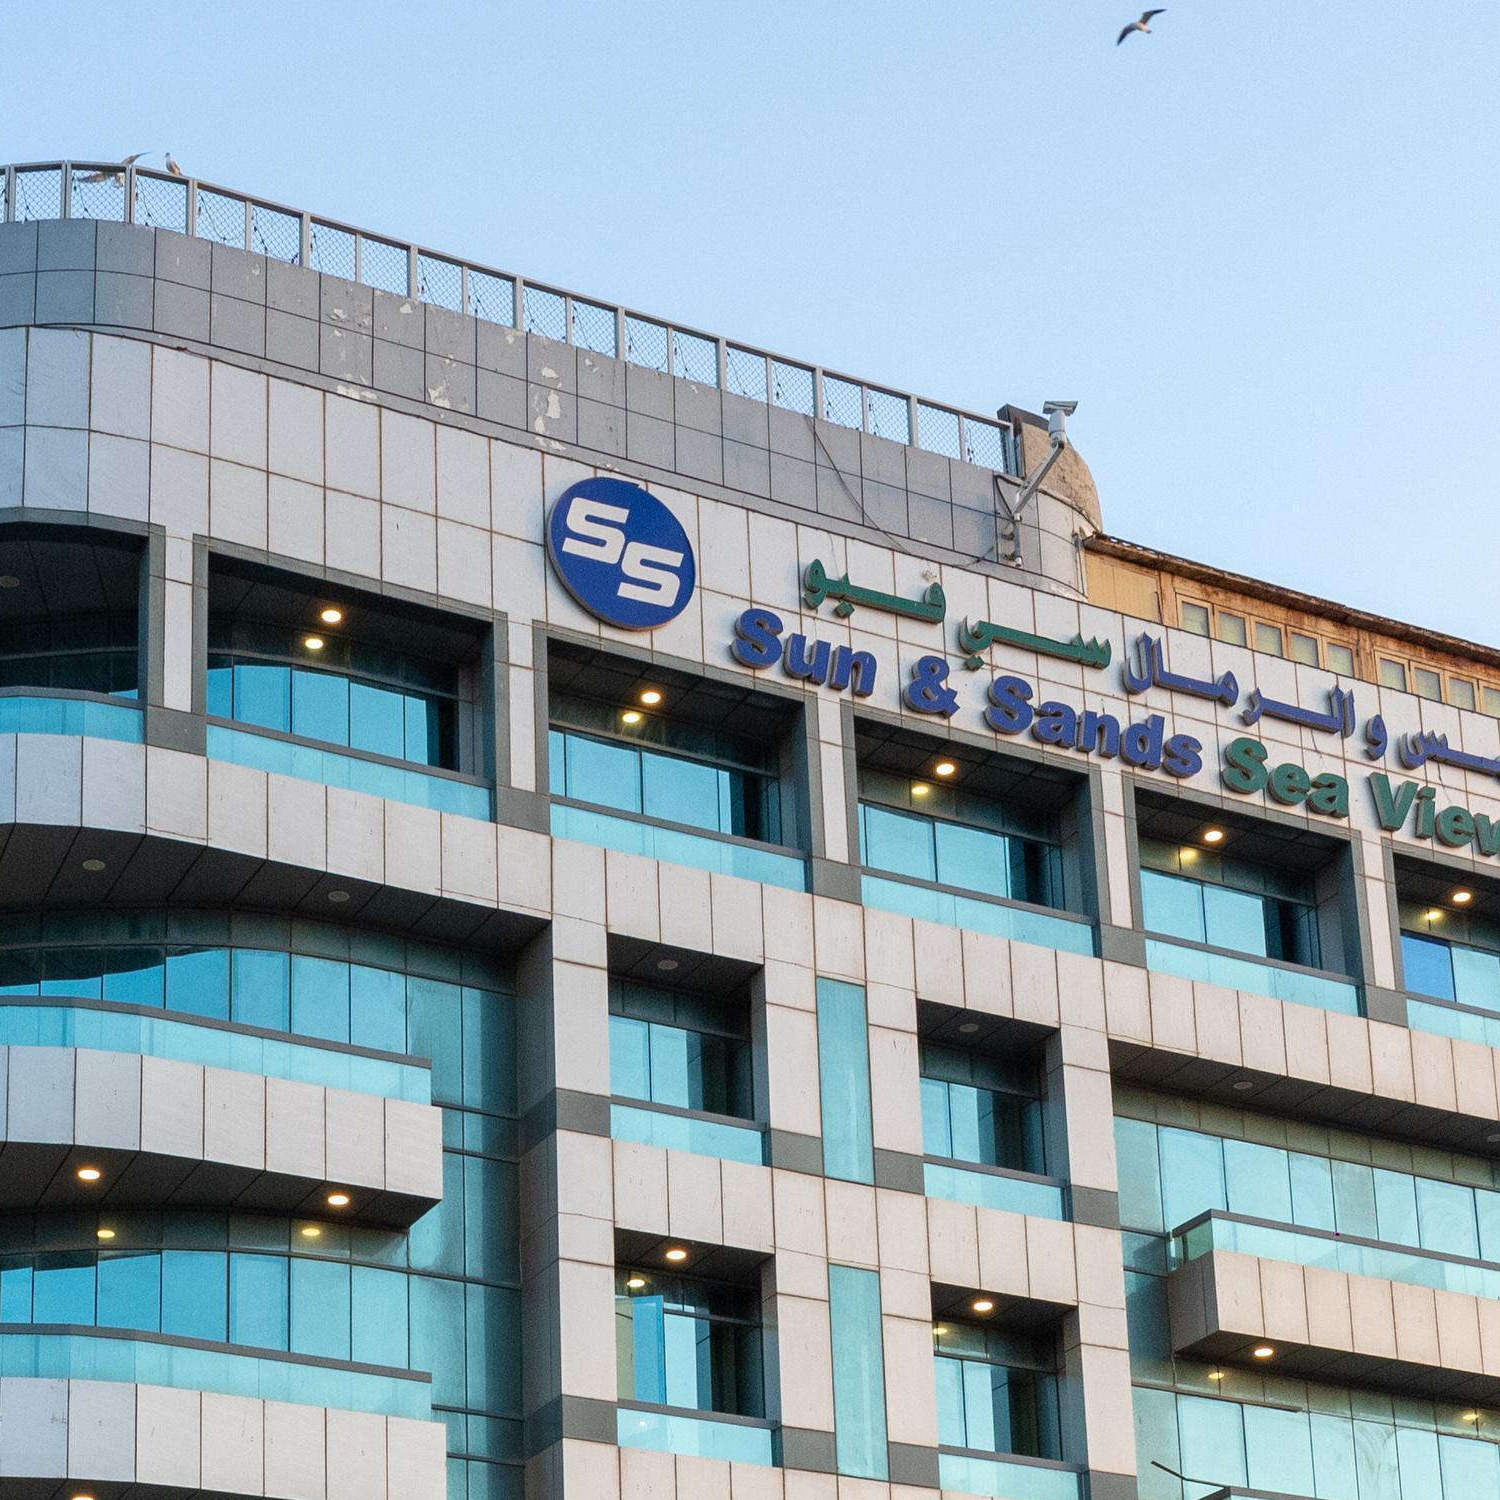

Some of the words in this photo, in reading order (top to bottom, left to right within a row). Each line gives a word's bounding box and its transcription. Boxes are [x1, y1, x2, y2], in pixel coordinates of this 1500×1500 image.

[562, 496, 684, 607] SS
[804, 558, 946, 623] فيو
[959, 616, 1111, 670] سي
[730, 608, 877, 698] Sun
[903, 655, 959, 719] &
[984, 675, 1203, 778] Sands
[1222, 737, 1349, 818] Sea
